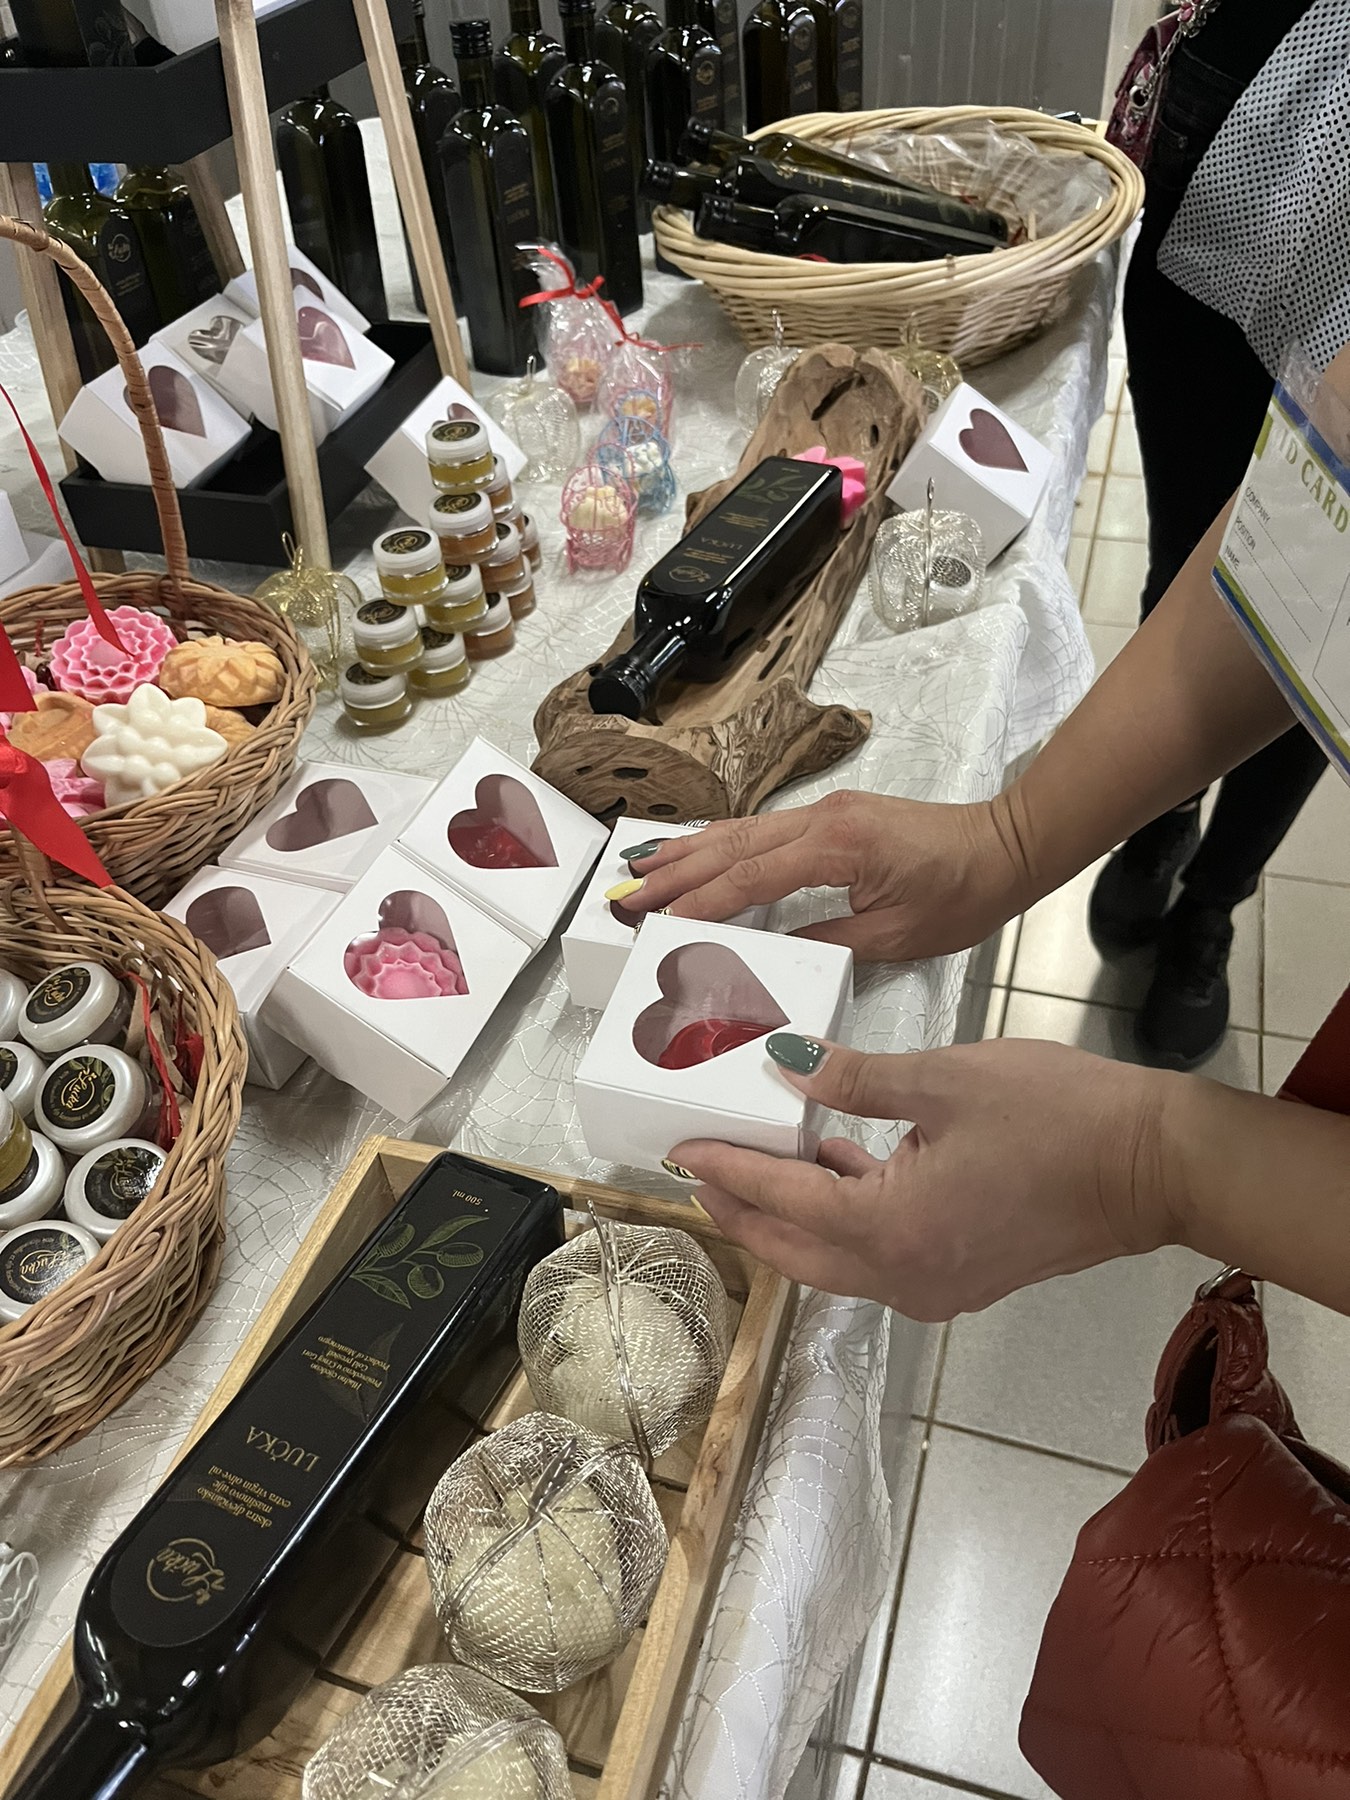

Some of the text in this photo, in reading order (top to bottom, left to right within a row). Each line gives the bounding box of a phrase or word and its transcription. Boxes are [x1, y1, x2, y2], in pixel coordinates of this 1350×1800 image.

[1279, 428, 1348, 533] ID CARD
[1245, 486, 1271, 524] COMPANY
[1235, 515, 1256, 550] POSITION
[1225, 545, 1240, 570] NAME
[452, 1189, 483, 1206] 500 ml
[317, 1335, 358, 1357] Montenegro
[326, 1350, 369, 1372] Cold pressed
[365, 1354, 391, 1371] Product
[246, 1425, 320, 1473] LUČKA
[208, 1465, 292, 1509] extra virgin olive oil
[212, 1480, 273, 1514] maslinovo ulje
[245, 1510, 273, 1529] ekstra
[156, 1547, 224, 1588] Lučka
